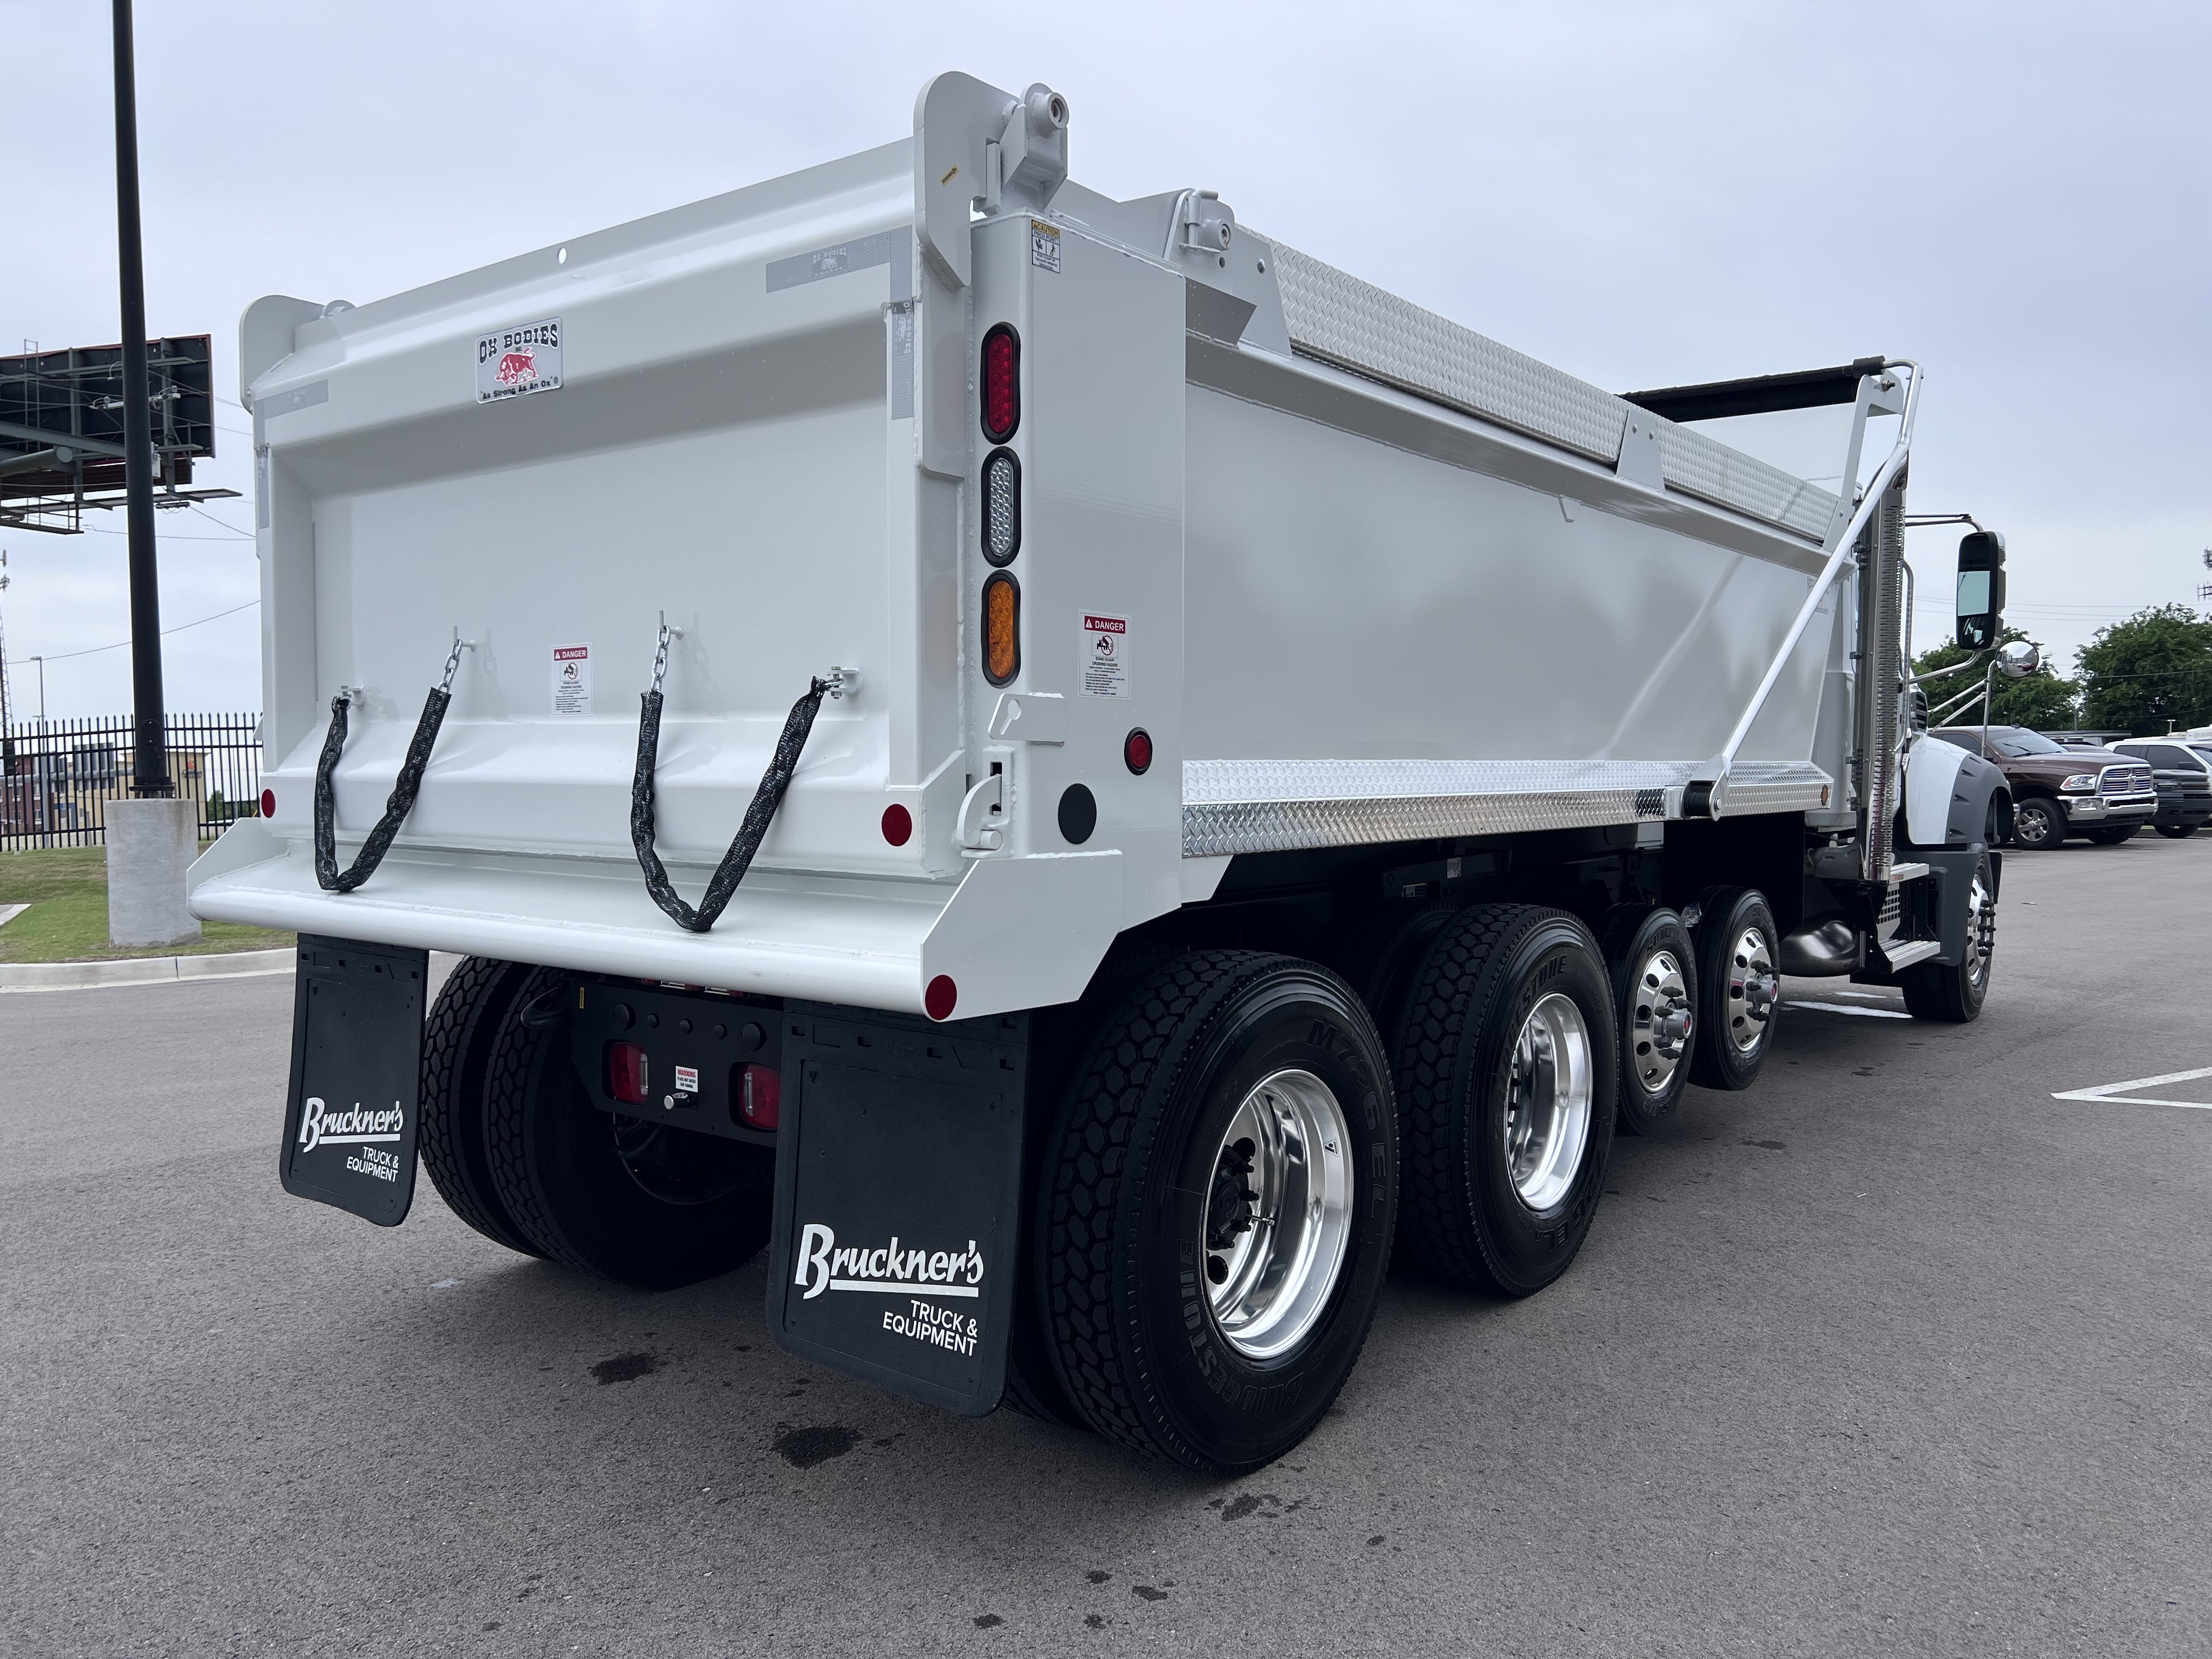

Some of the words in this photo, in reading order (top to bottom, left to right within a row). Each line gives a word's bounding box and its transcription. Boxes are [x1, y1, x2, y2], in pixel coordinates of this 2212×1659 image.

[1034, 230, 1045, 239] PINCH
[1037, 223, 1059, 237] CAUTION
[479, 337, 498, 364] OX
[504, 323, 558, 349] BODIES
[494, 388, 516, 397] Strong
[1094, 620, 1124, 631] DANGER
[562, 650, 586, 658] DANGER
[678, 1069, 696, 1077] WARNING
[1306, 1019, 1381, 1130] M726
[299, 1097, 404, 1153] Bruckner's
[346, 1156, 398, 1183] EQUIPMENT
[363, 1146, 391, 1167] TRUCK
[392, 1155, 399, 1169] &
[795, 1223, 984, 1300] Bruckner's
[911, 1299, 964, 1333] TRUCK
[967, 1318, 978, 1338] &
[1179, 1238, 1305, 1418] BRIDGESTONE
[882, 1311, 977, 1357] EQUIPMENT
